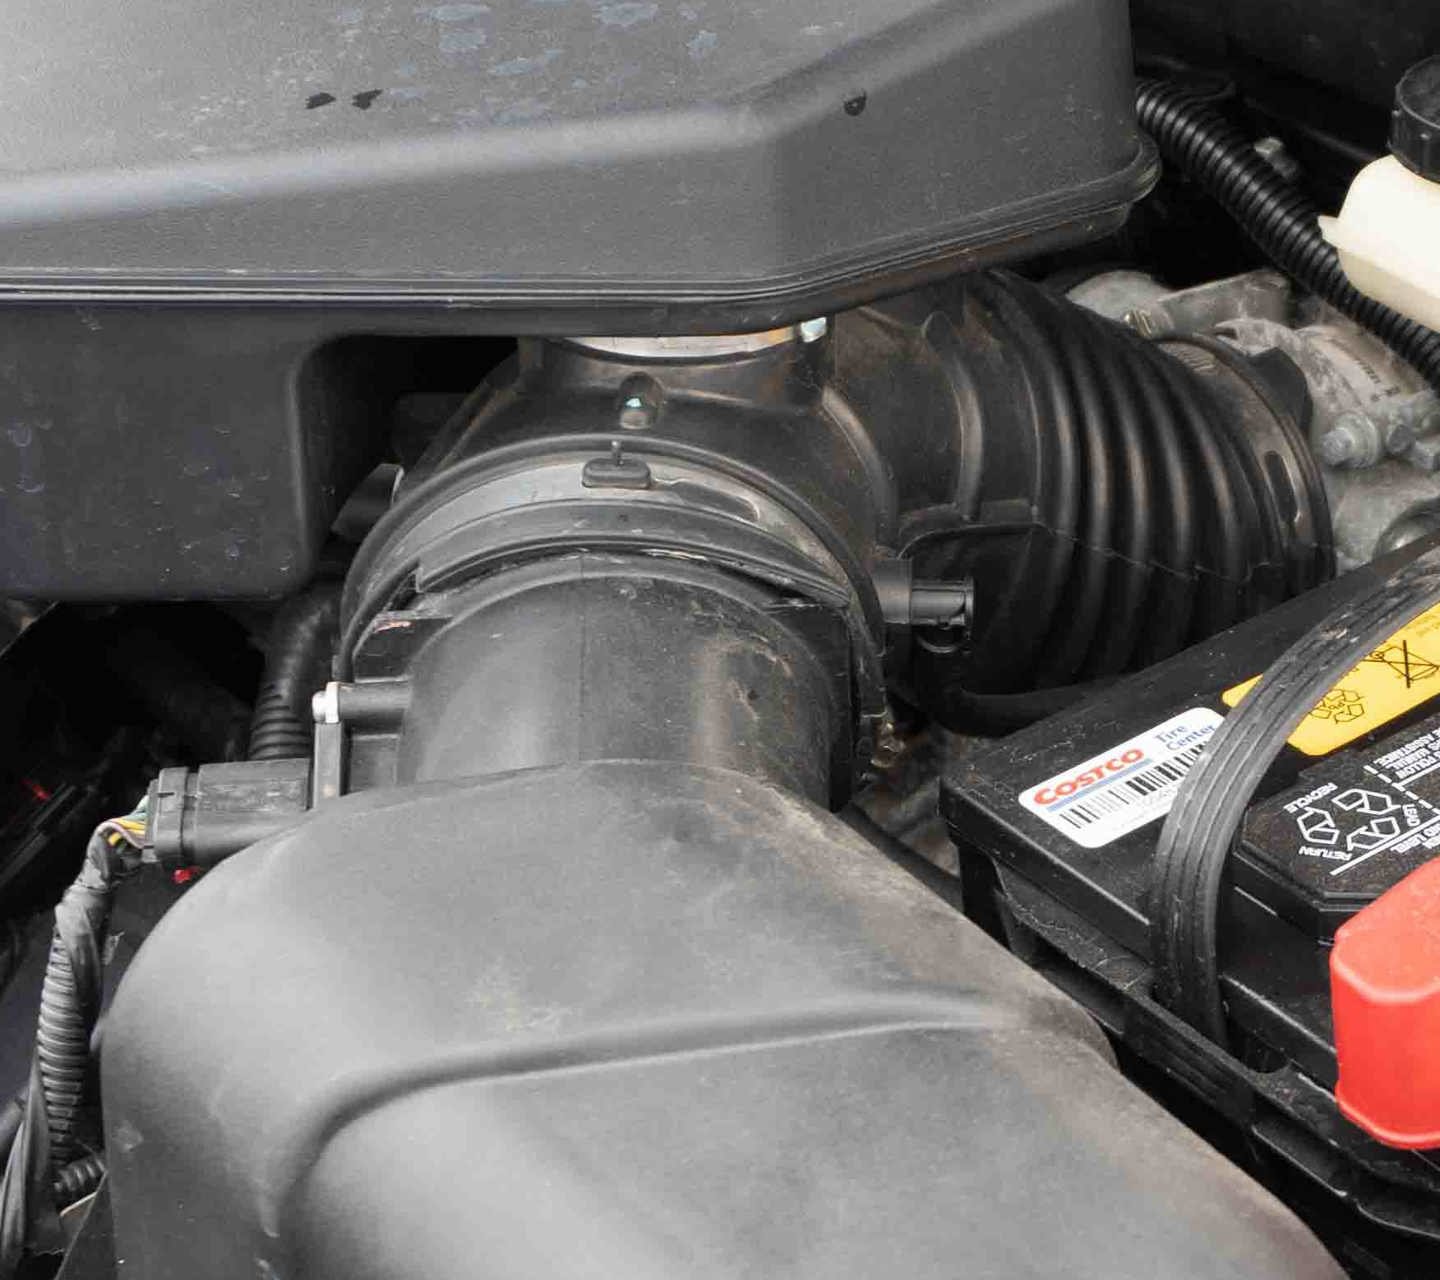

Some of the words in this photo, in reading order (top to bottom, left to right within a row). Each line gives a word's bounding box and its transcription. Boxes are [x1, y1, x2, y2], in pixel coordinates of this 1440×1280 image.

[1155, 726, 1186, 742] Tire
[1166, 725, 1220, 750] Center
[1034, 749, 1143, 804] COSTCO
[1284, 783, 1337, 812] RECYCLE
